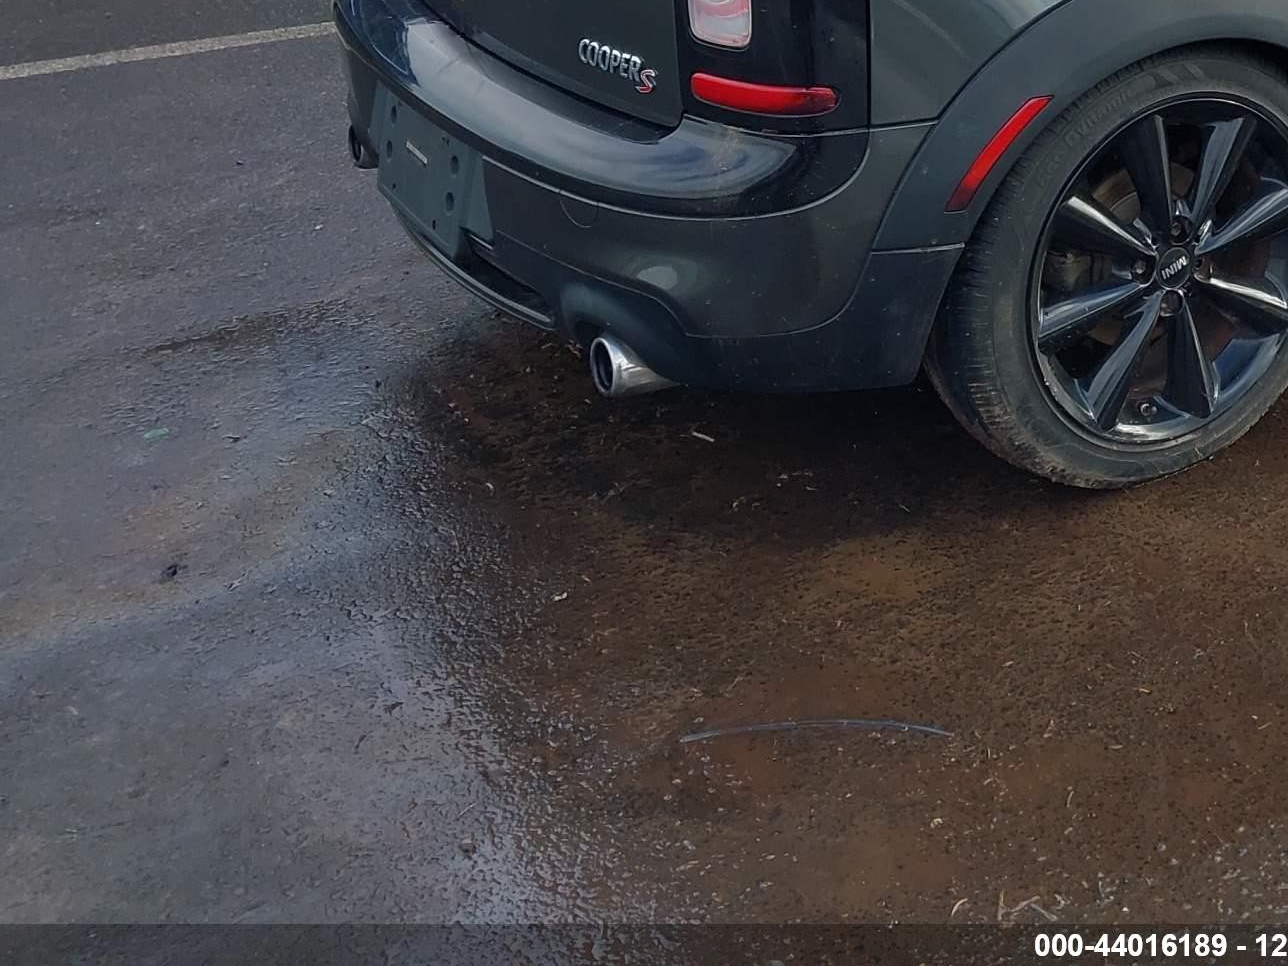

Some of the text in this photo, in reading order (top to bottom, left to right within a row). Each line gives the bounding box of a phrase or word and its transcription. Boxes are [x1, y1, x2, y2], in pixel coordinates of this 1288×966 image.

[578, 38, 656, 94] COOPER S
[1161, 255, 1187, 280] MINI
